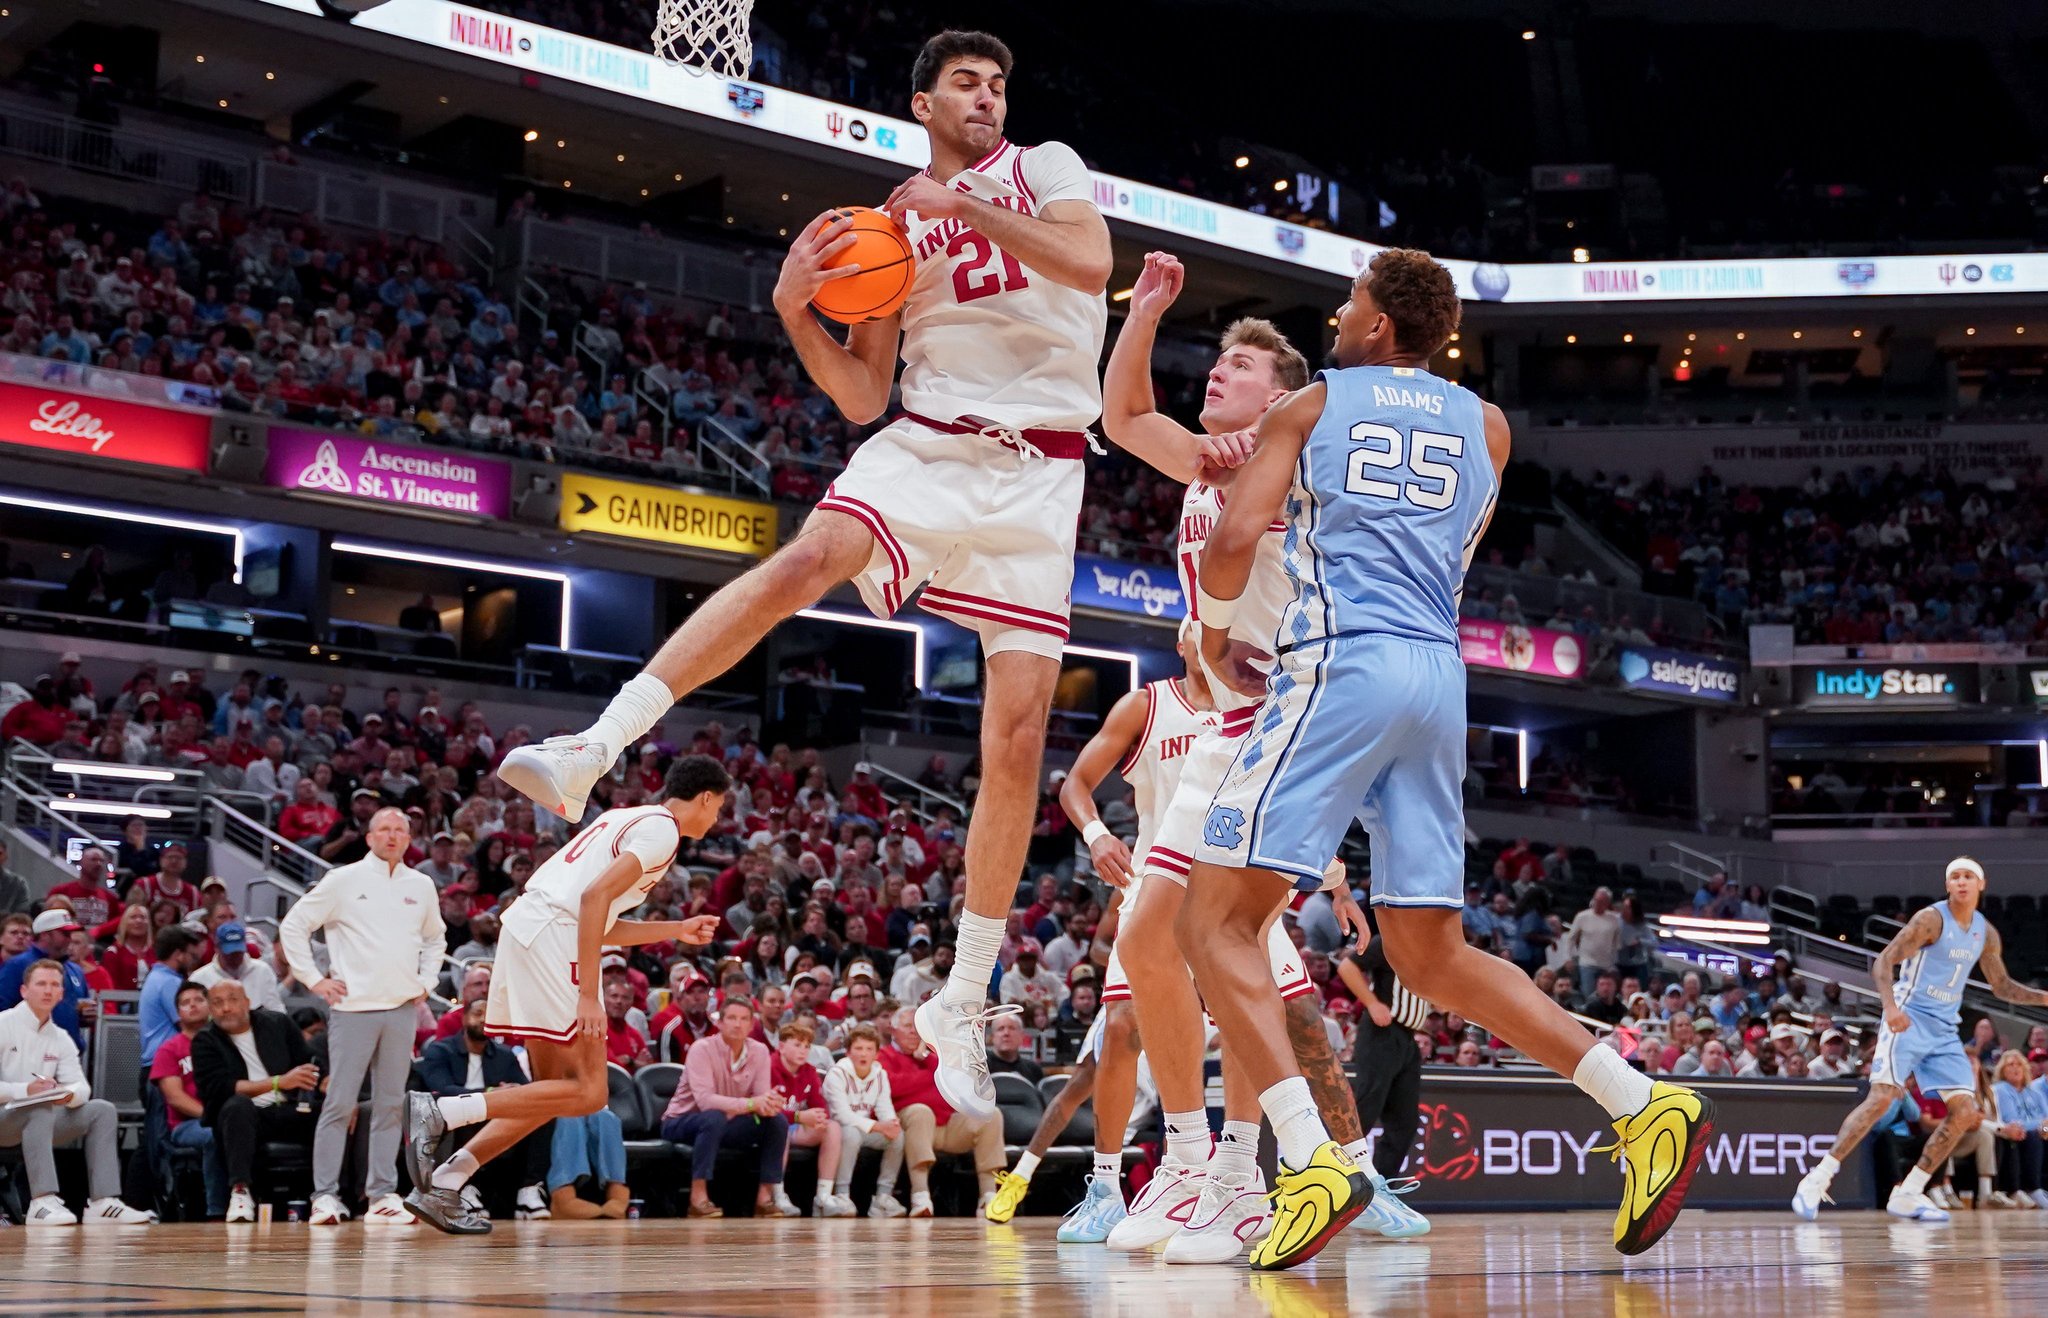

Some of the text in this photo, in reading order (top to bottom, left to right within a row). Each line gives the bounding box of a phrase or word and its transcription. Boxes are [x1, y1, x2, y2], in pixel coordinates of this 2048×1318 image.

[450, 12, 650, 90] INDIANA NORTH CAROLINA
[945, 229, 1029, 304] 21
[1583, 270, 1638, 292] INDIANA
[1373, 385, 1444, 415] ADAMS
[30, 400, 115, 452] Lilly
[360, 446, 478, 484] Ascension
[1344, 421, 1464, 511] 25
[1713, 446, 1745, 459] TEXT
[357, 472, 480, 512] St. Vincent
[608, 495, 767, 546] GAINBRIDGE
[1121, 569, 1181, 617] Kroger
[1652, 658, 1738, 693] salesforce
[1816, 669, 1955, 700] IndyStar.
[565, 822, 609, 864] 0
[1949, 949, 1974, 961] NORTH
[1947, 963, 1963, 988] 1
[1483, 1129, 1841, 1175] BOY WERS
